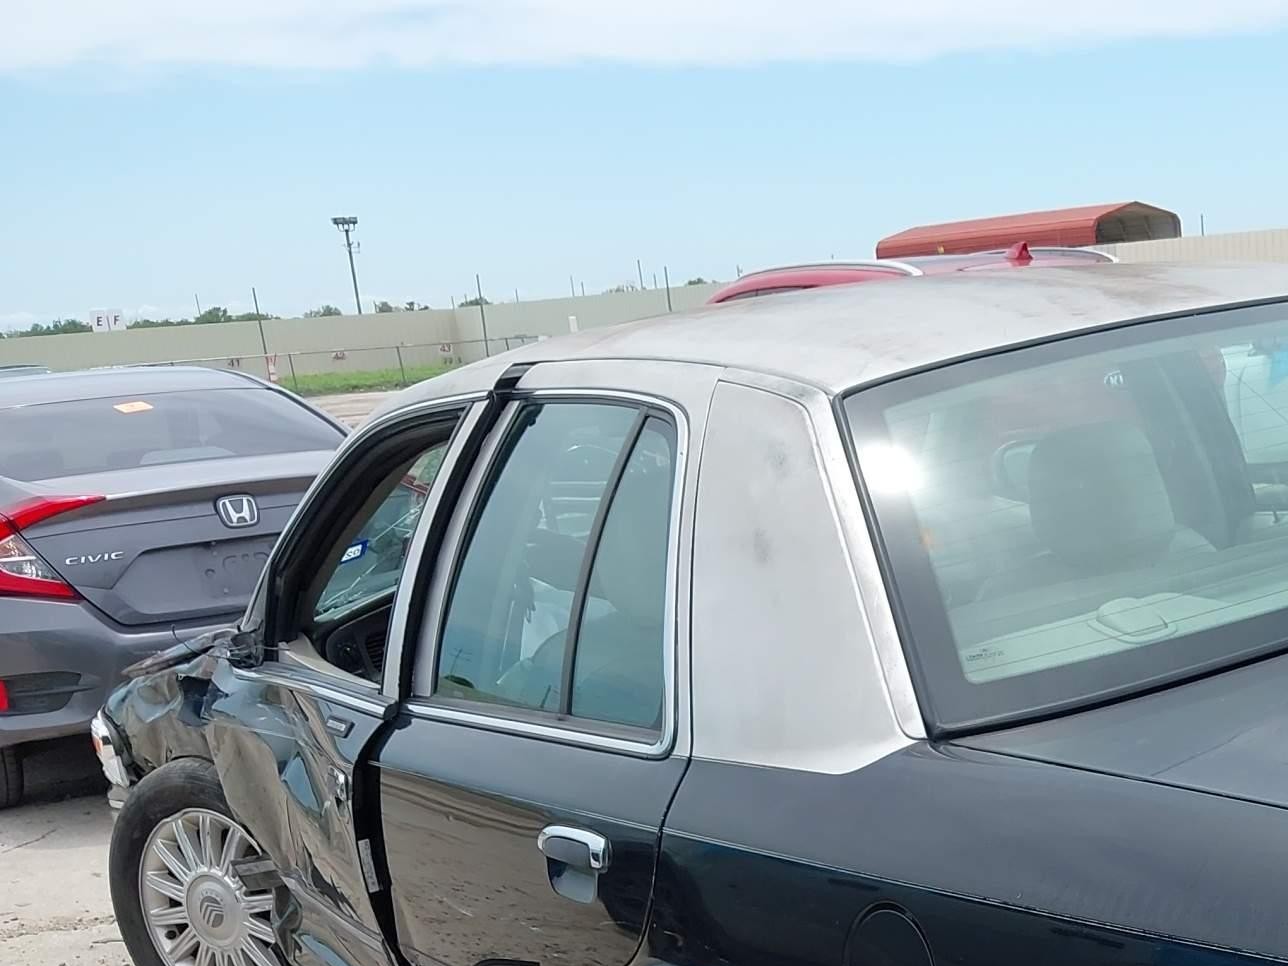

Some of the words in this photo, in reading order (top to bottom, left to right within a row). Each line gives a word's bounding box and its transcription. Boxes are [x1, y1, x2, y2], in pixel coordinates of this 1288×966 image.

[96, 316, 103, 327] E
[113, 315, 120, 326] F
[64, 551, 124, 565] CIVIC
